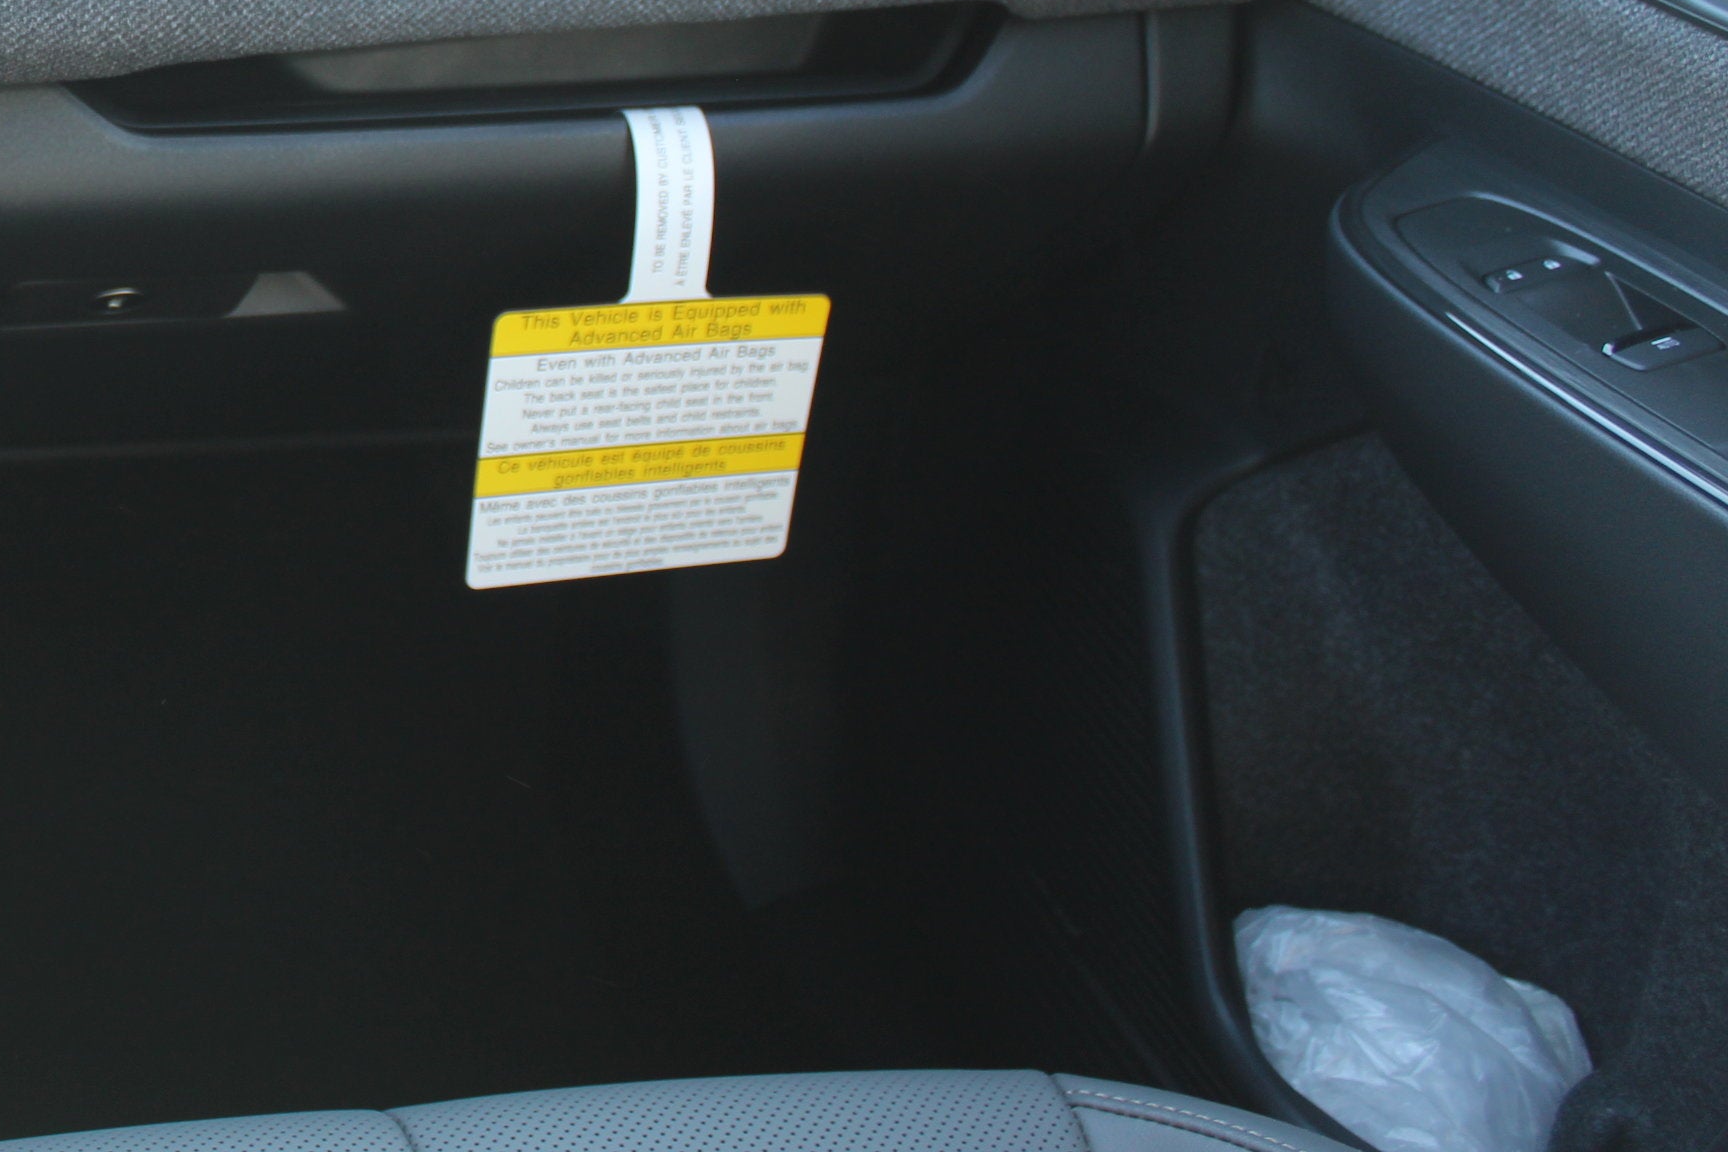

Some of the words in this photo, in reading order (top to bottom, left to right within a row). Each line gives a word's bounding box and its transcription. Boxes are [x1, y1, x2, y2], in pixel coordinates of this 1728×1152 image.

[678, 128, 693, 164] CLIENT
[659, 173, 669, 187] BY
[683, 169, 694, 181] LE
[682, 186, 693, 206] PAR
[657, 190, 668, 240] REMOVED
[655, 245, 665, 258] BE
[652, 260, 663, 273] TO
[522, 315, 561, 331] This
[571, 311, 639, 327] Vehicle
[648, 308, 663, 322] is
[672, 302, 762, 323] Equipped
[770, 300, 807, 316] with
[569, 326, 663, 346] Advanced
[672, 325, 698, 339] Air
[706, 322, 753, 340] Bags
[537, 358, 577, 372] Even
[585, 355, 616, 367] with
[623, 348, 701, 366] Advanced
[709, 347, 730, 359] Air
[737, 345, 777, 361] Bags
[494, 378, 540, 392] Children
[497, 461, 520, 475] Ce
[693, 445, 711, 457] de
